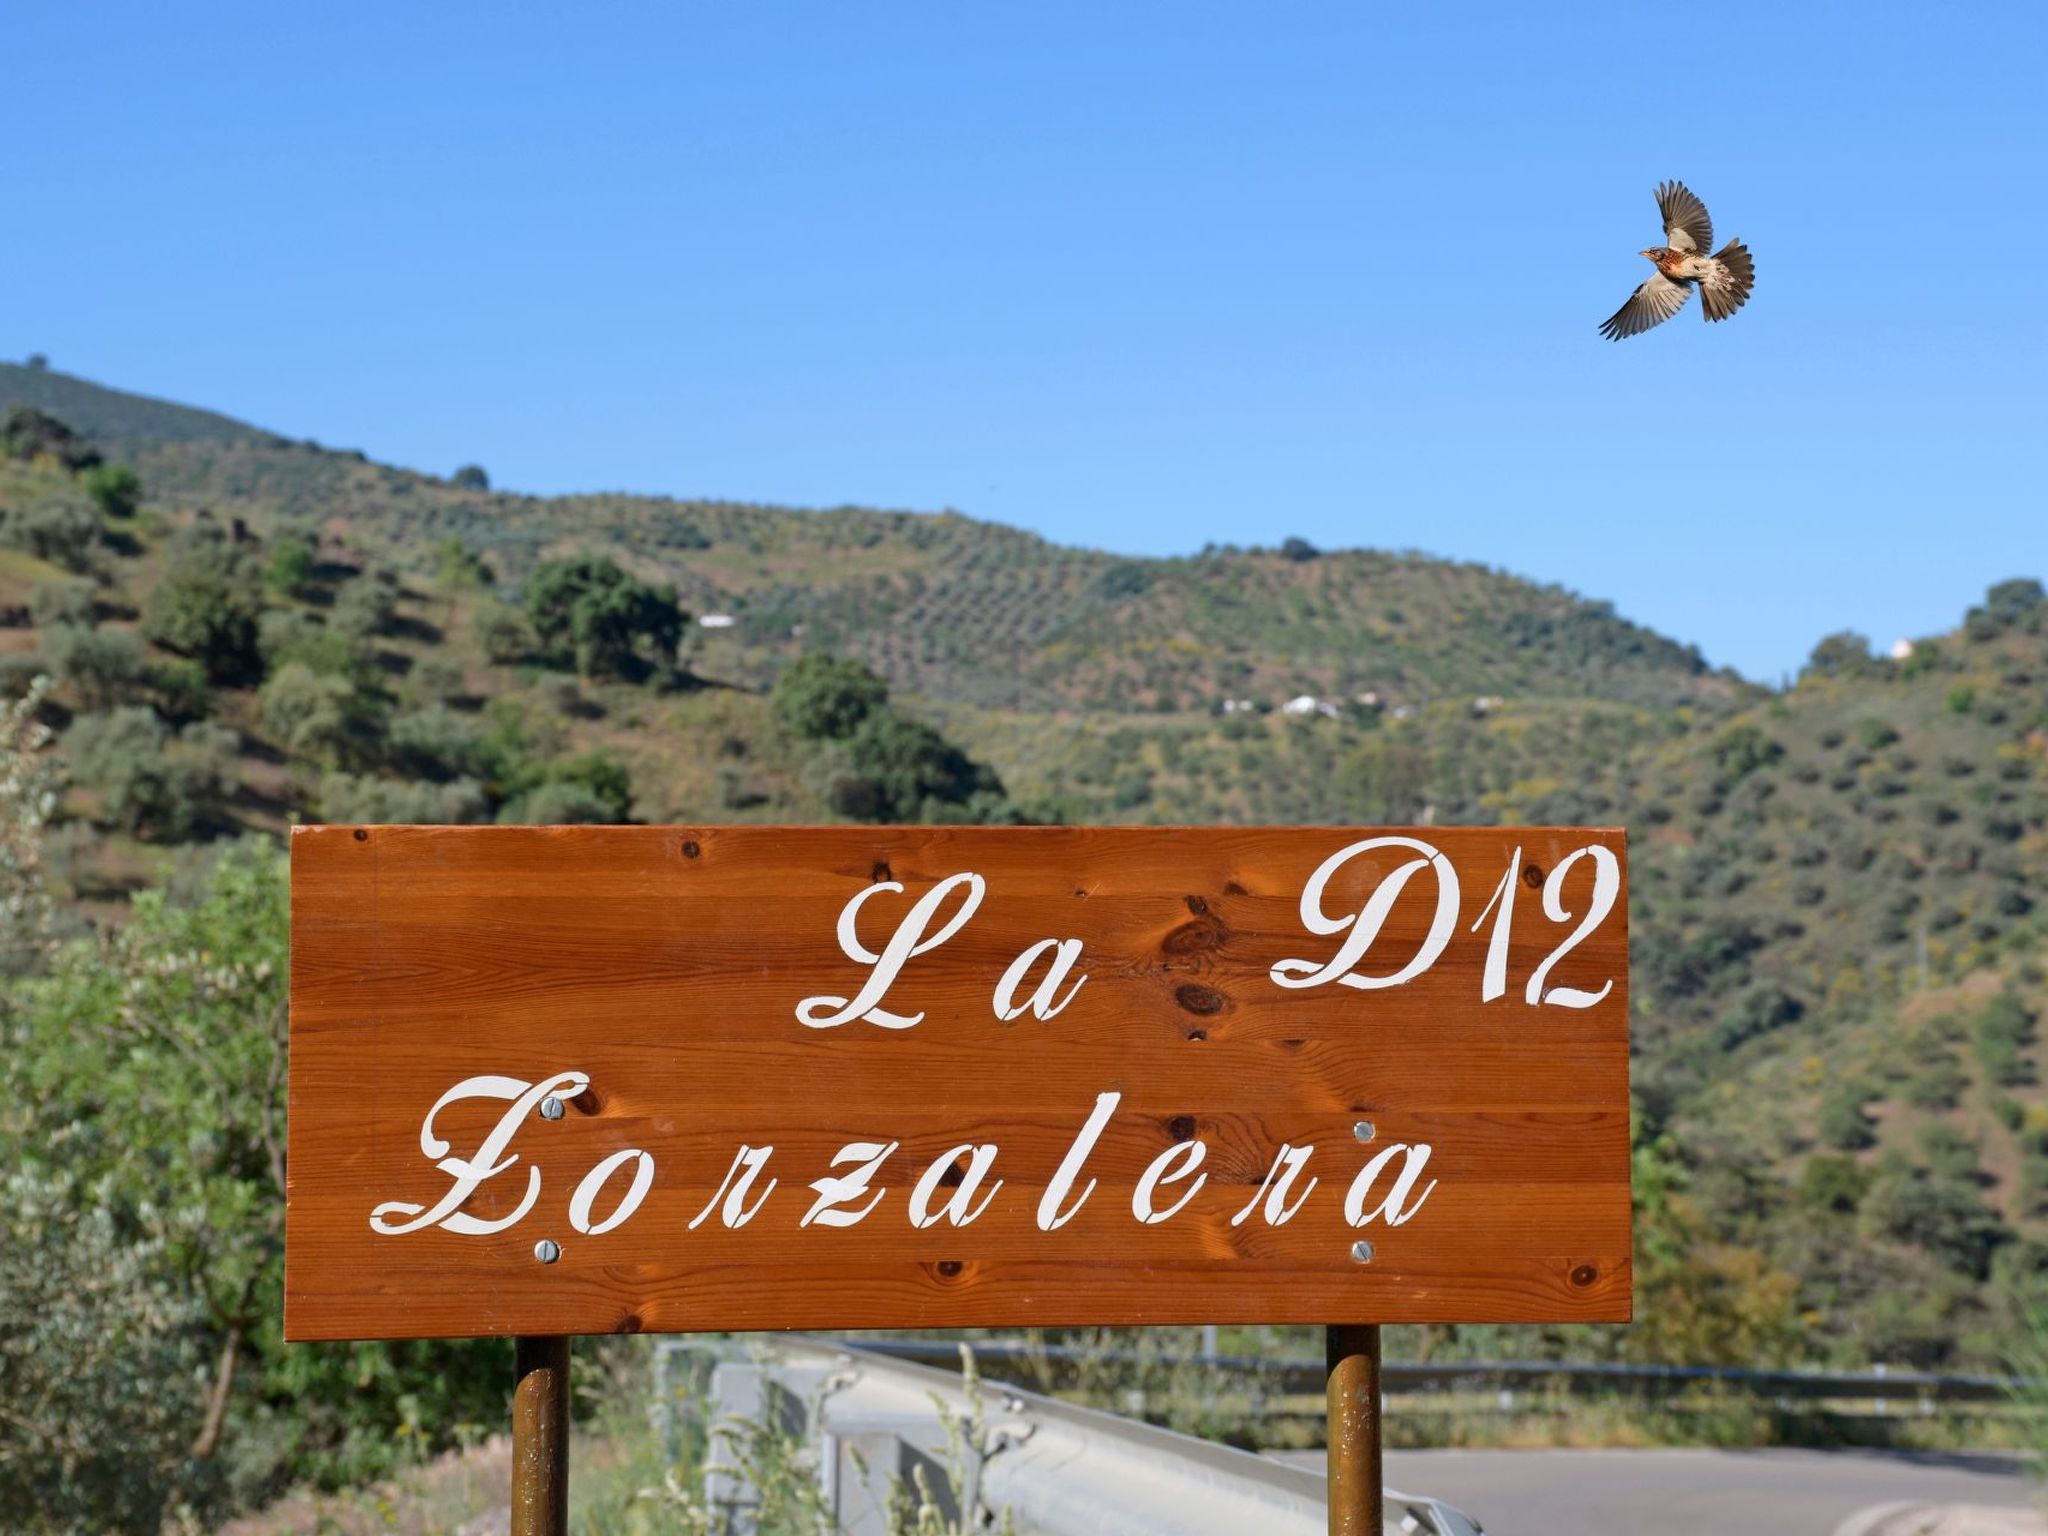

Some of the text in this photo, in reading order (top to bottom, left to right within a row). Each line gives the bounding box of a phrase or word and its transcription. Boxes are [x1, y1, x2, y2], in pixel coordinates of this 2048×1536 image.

[796, 872, 1088, 1029] La
[1270, 836, 1621, 1009] D12
[370, 1072, 1438, 1235] Zorzalera
